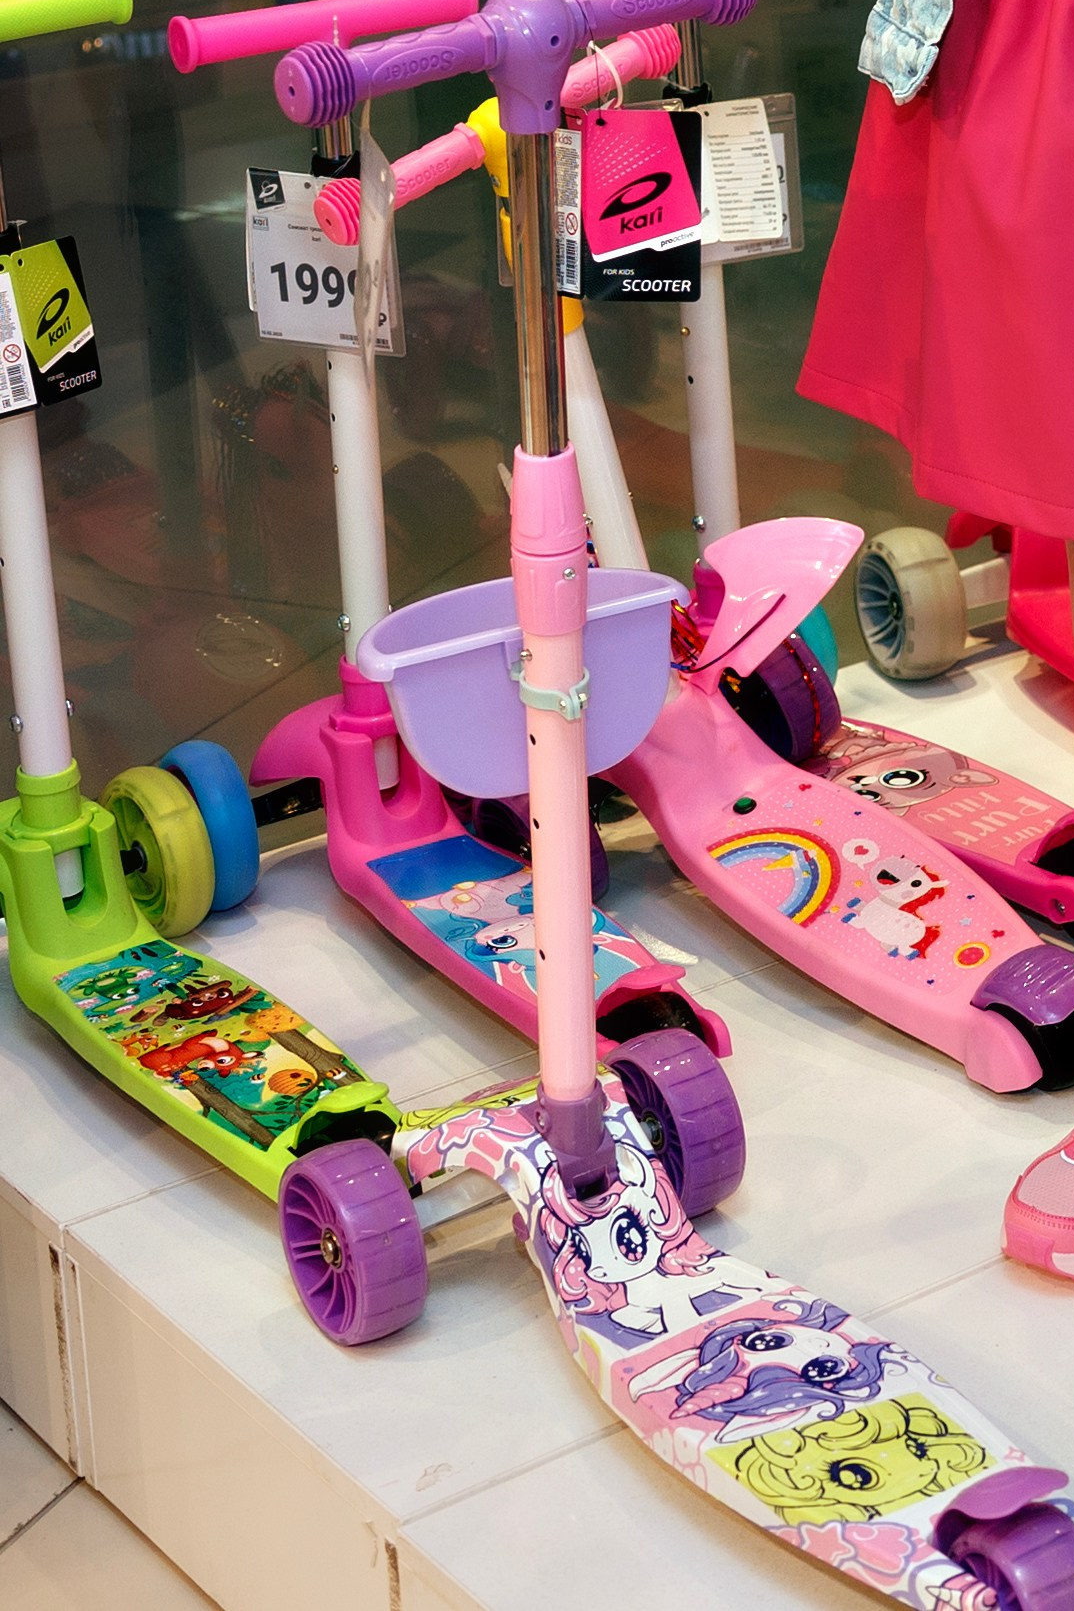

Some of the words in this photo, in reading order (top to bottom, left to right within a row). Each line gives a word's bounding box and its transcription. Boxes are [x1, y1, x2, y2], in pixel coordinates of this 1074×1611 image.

[383, 50, 455, 81] Scooter
[396, 158, 450, 195] Scooter
[620, 205, 663, 235] kari
[661, 231, 695, 248] proactive
[621, 279, 692, 292] SCOOTER
[48, 316, 72, 346] kari
[59, 370, 97, 392] SCOOTER
